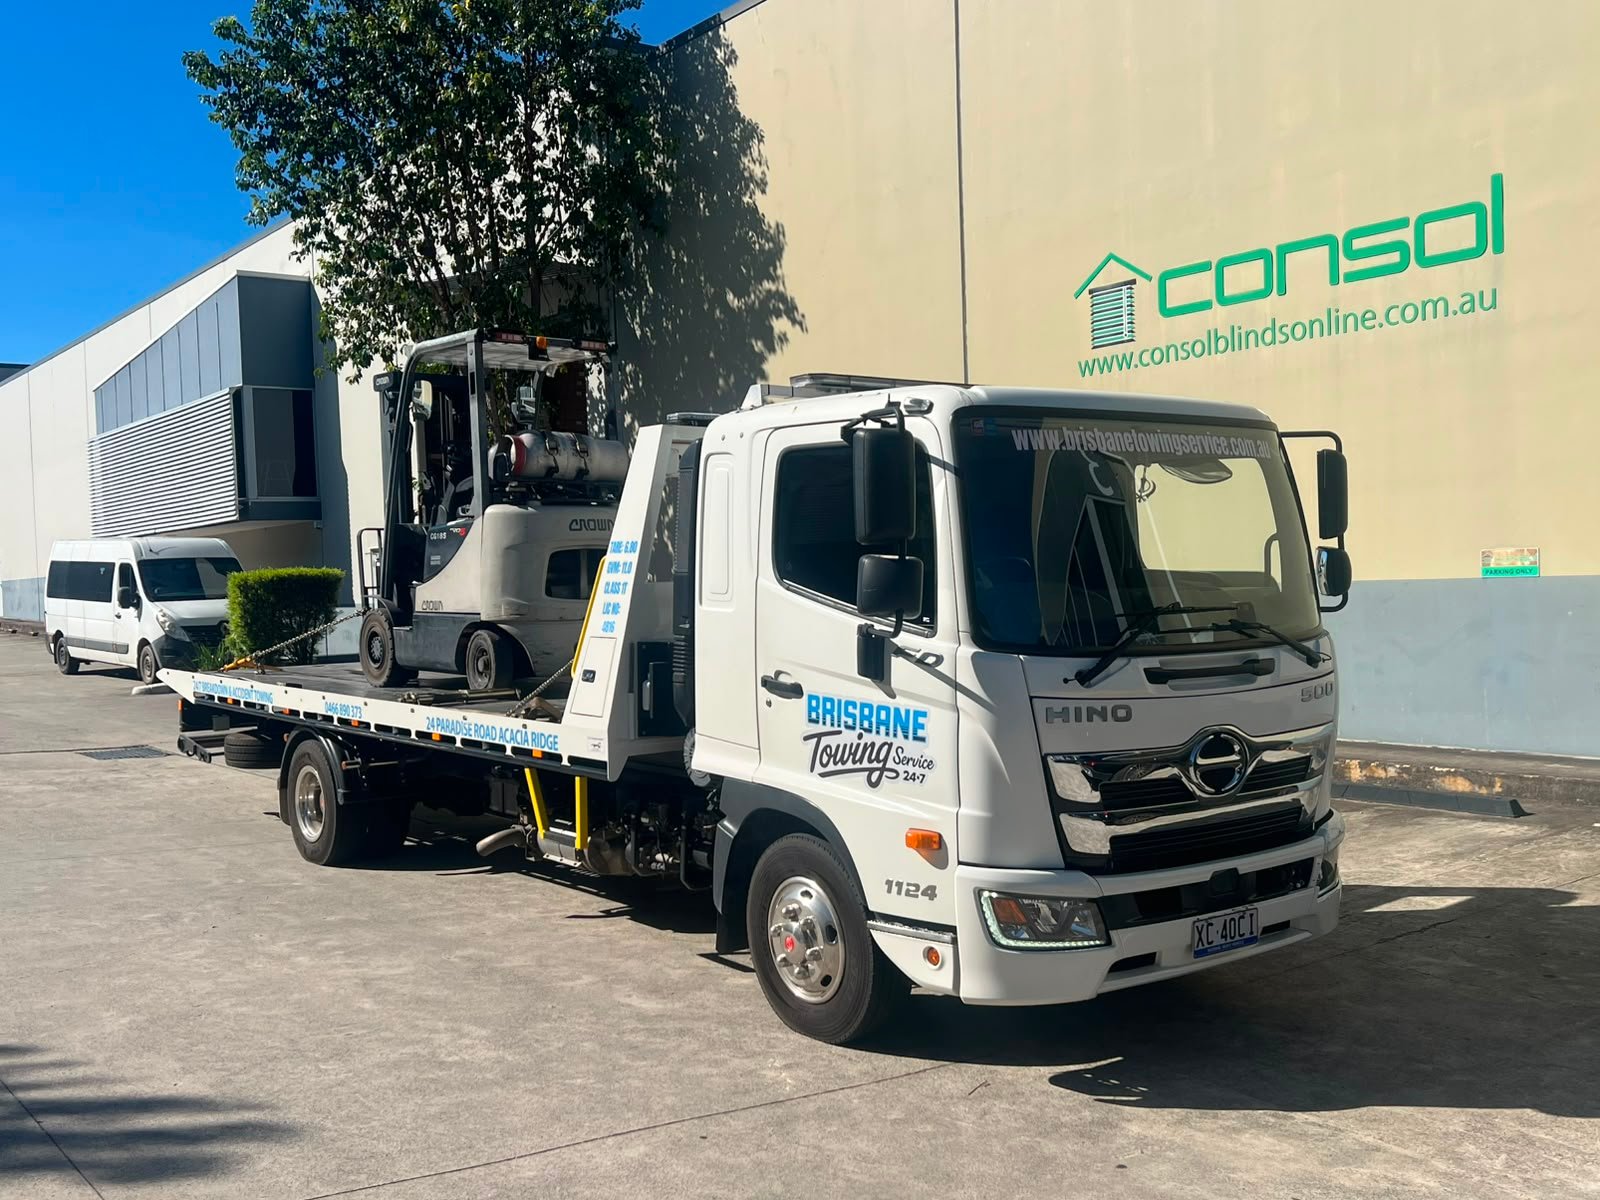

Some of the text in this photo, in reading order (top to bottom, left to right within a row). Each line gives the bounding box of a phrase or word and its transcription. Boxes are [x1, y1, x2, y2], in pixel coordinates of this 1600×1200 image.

[1157, 172, 1505, 318] consol
[1077, 287, 1498, 378] www.consolblindsonline.com.au
[1011, 426, 1271, 459] www.brisbanetowingservice.com.au
[603, 581, 621, 594] CLASS
[232, 686, 254, 700] ACCIDENT
[253, 689, 274, 704] TOWING
[1300, 681, 1333, 703] 500
[807, 693, 928, 743] BRISBANE
[1045, 704, 1133, 724] HINO
[426, 716, 559, 751] 24 PARADISE ROAD ACACIA RIDGE
[802, 730, 934, 789] Towing Service
[884, 879, 937, 901] 1124
